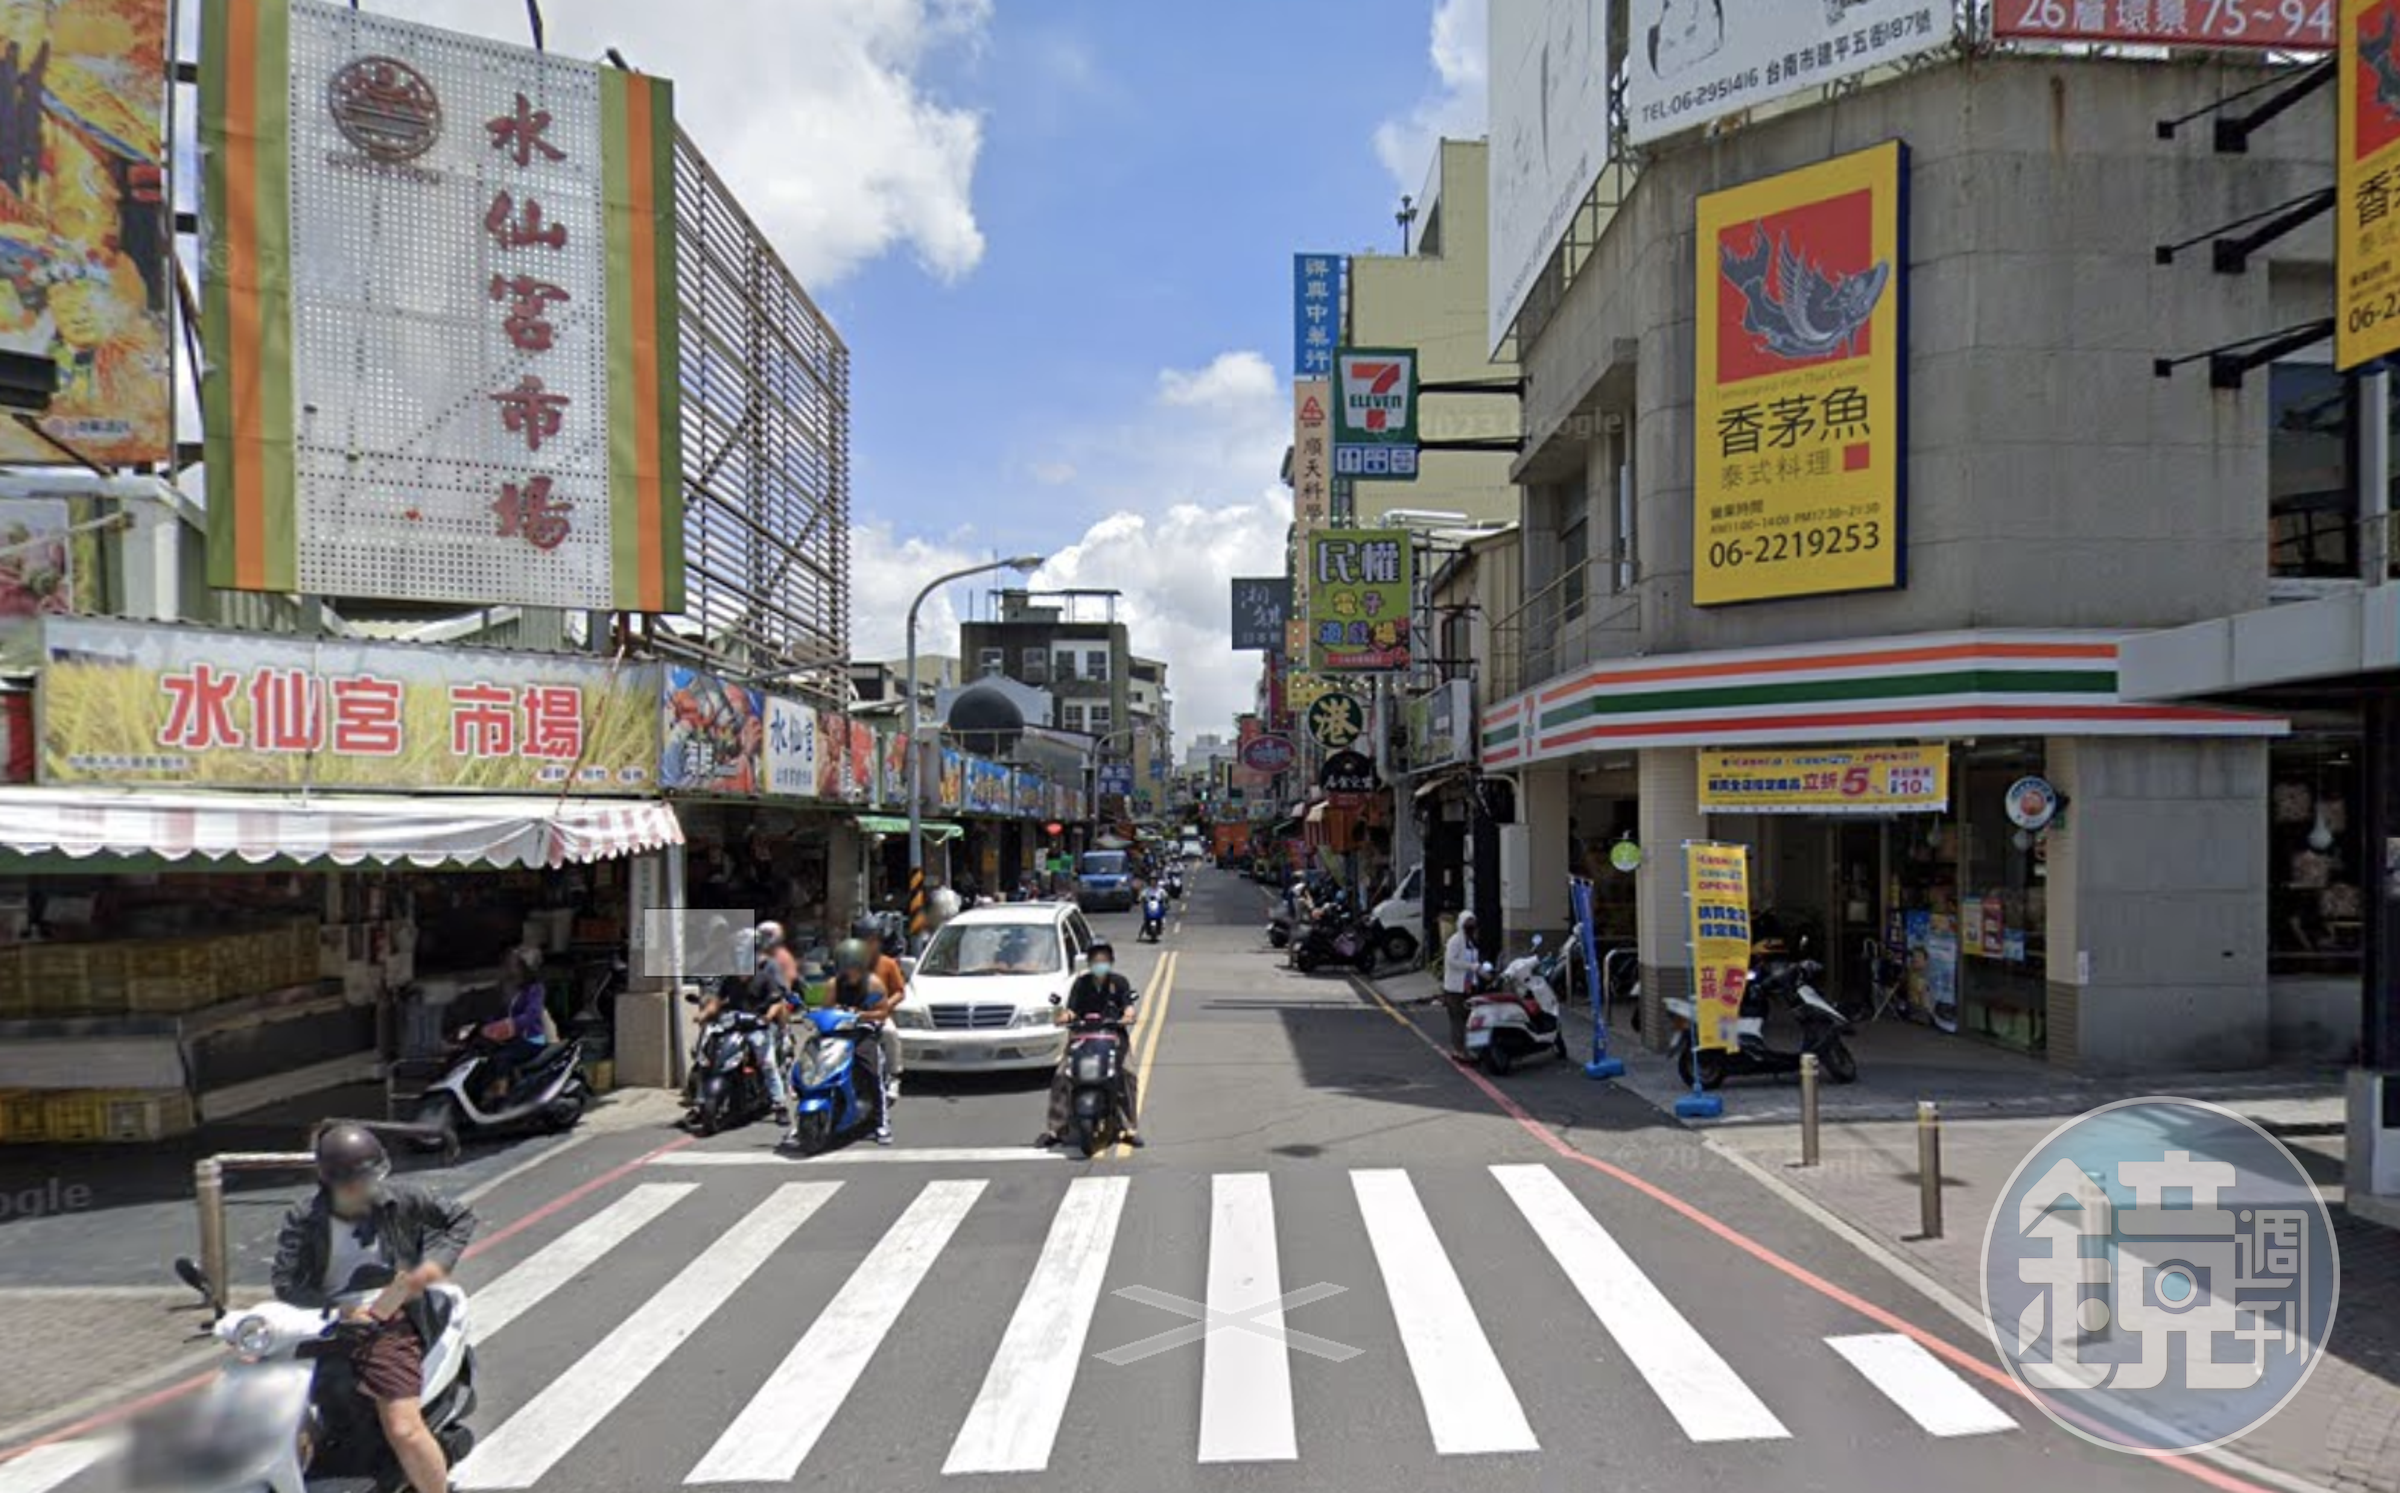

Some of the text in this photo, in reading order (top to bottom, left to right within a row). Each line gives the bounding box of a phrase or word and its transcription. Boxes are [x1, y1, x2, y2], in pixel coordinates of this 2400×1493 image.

[484, 92, 574, 552] 水仙宮市場
[2349, 291, 2400, 334] 06-2
[1717, 385, 1871, 459] 香茅魚
[1720, 448, 1832, 491] 泰式料理
[1317, 539, 1400, 584] 民權
[1709, 519, 1881, 570] 06-2219253
[157, 663, 583, 761] 水仙宮 市場
